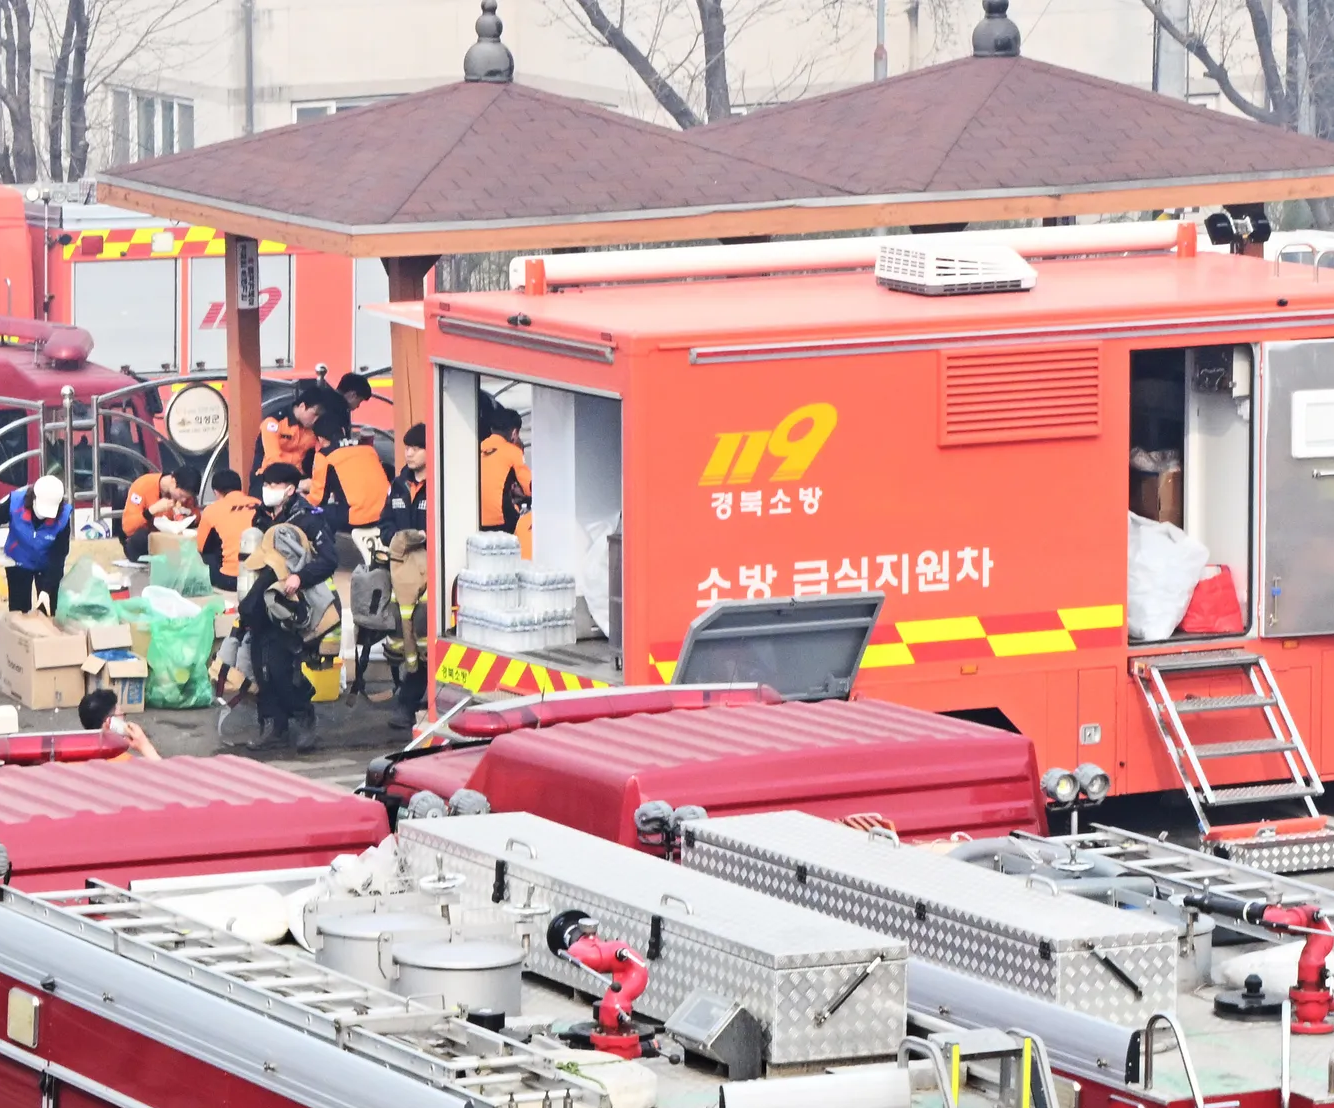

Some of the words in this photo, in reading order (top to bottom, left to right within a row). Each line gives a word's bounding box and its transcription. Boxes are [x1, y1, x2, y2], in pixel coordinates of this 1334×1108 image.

[697, 402, 838, 486] 119
[711, 487, 822, 520] 경북소방
[696, 564, 778, 608] 소방
[792, 546, 994, 597] 급식지원차
